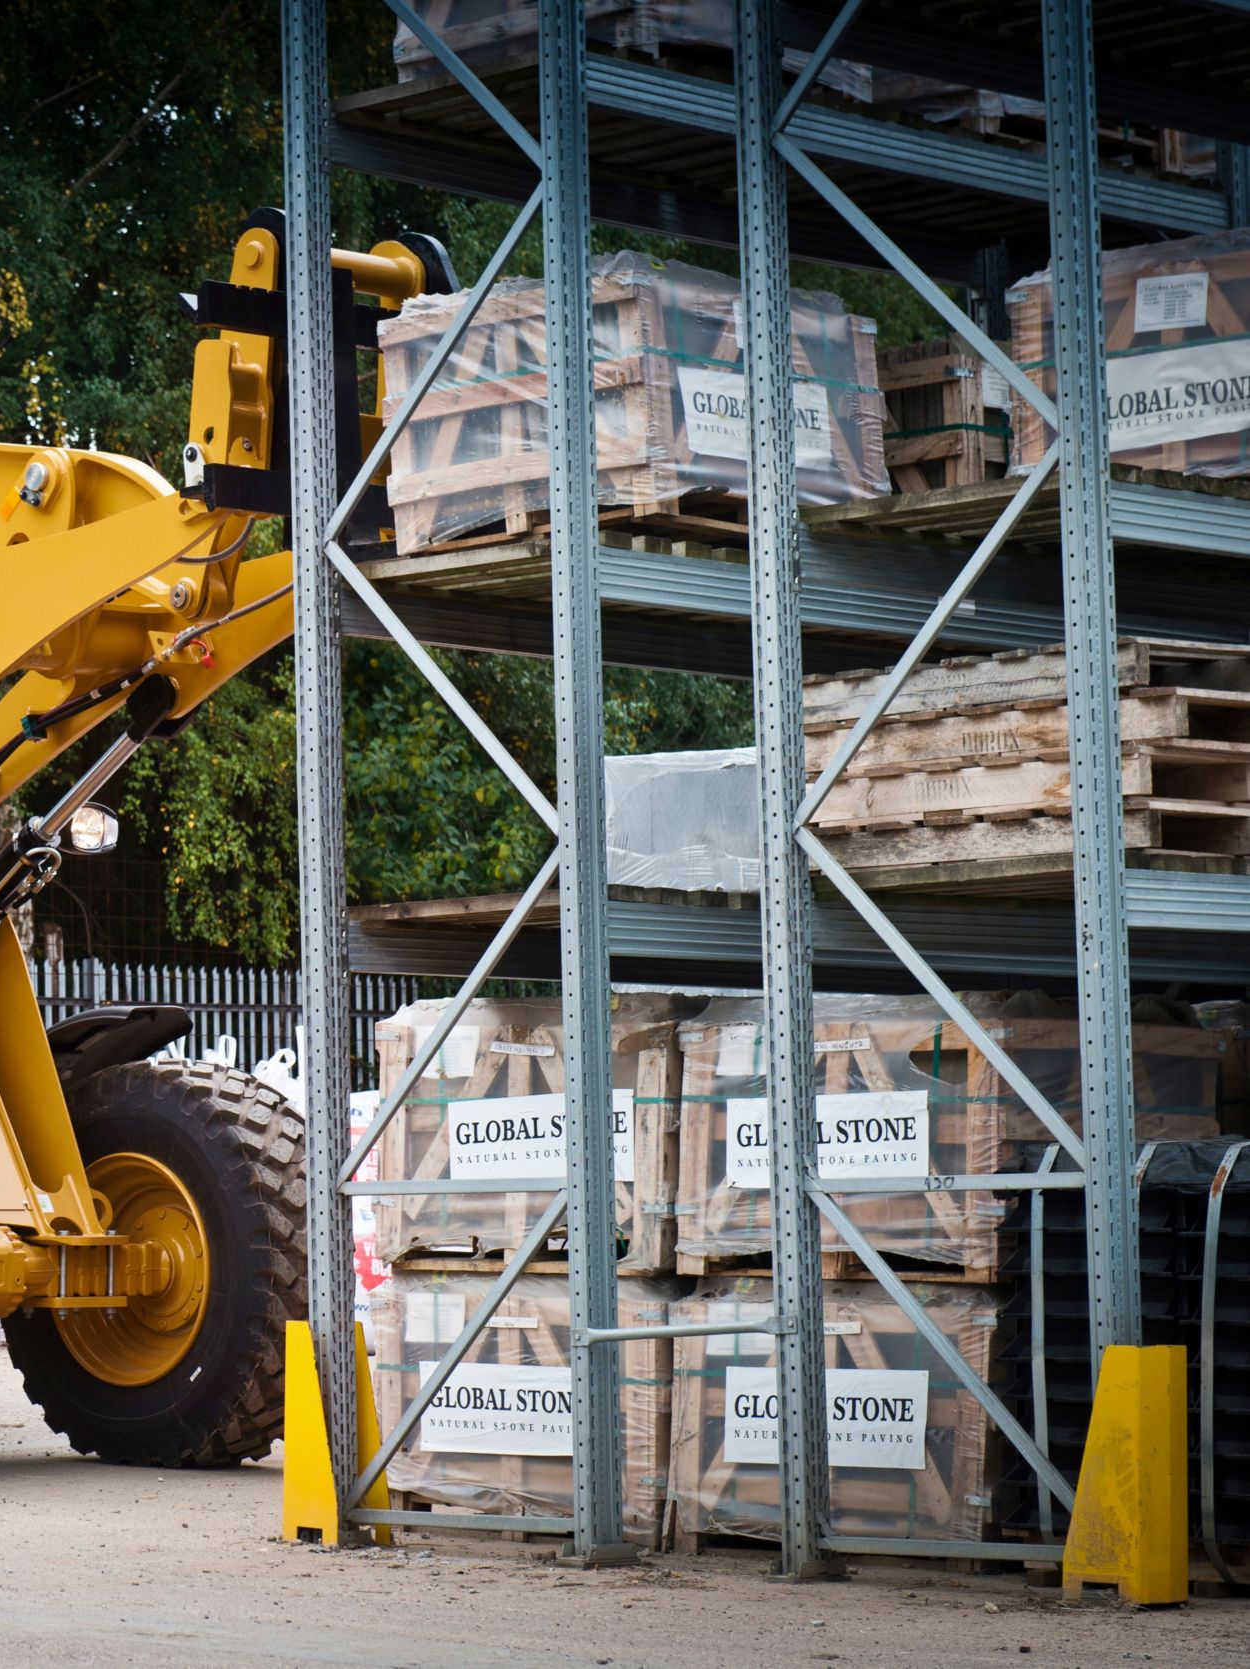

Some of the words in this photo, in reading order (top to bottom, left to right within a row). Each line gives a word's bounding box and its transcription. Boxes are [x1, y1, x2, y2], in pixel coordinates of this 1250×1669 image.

[693, 391, 747, 420] GLOBA
[1106, 387, 1179, 420] LOBAL
[1183, 375, 1250, 408] STON
[1108, 417, 1150, 432] TURAL
[1157, 409, 1206, 424] STONE
[1214, 402, 1250, 416] PAVI
[455, 1116, 546, 1146] GLOBAL
[836, 1116, 917, 1144] STONE
[457, 1151, 517, 1165] NATURAL
[819, 1155, 855, 1166] TONE
[864, 1152, 918, 1164] PAVING
[516, 1388, 572, 1413] STON
[832, 1396, 914, 1422] STONE
[430, 1418, 485, 1430] NATURAL
[493, 1421, 535, 1432] STONE
[542, 1424, 571, 1434] PAVI
[734, 1429, 778, 1440] NATUR
[861, 1432, 914, 1444] PAVING
